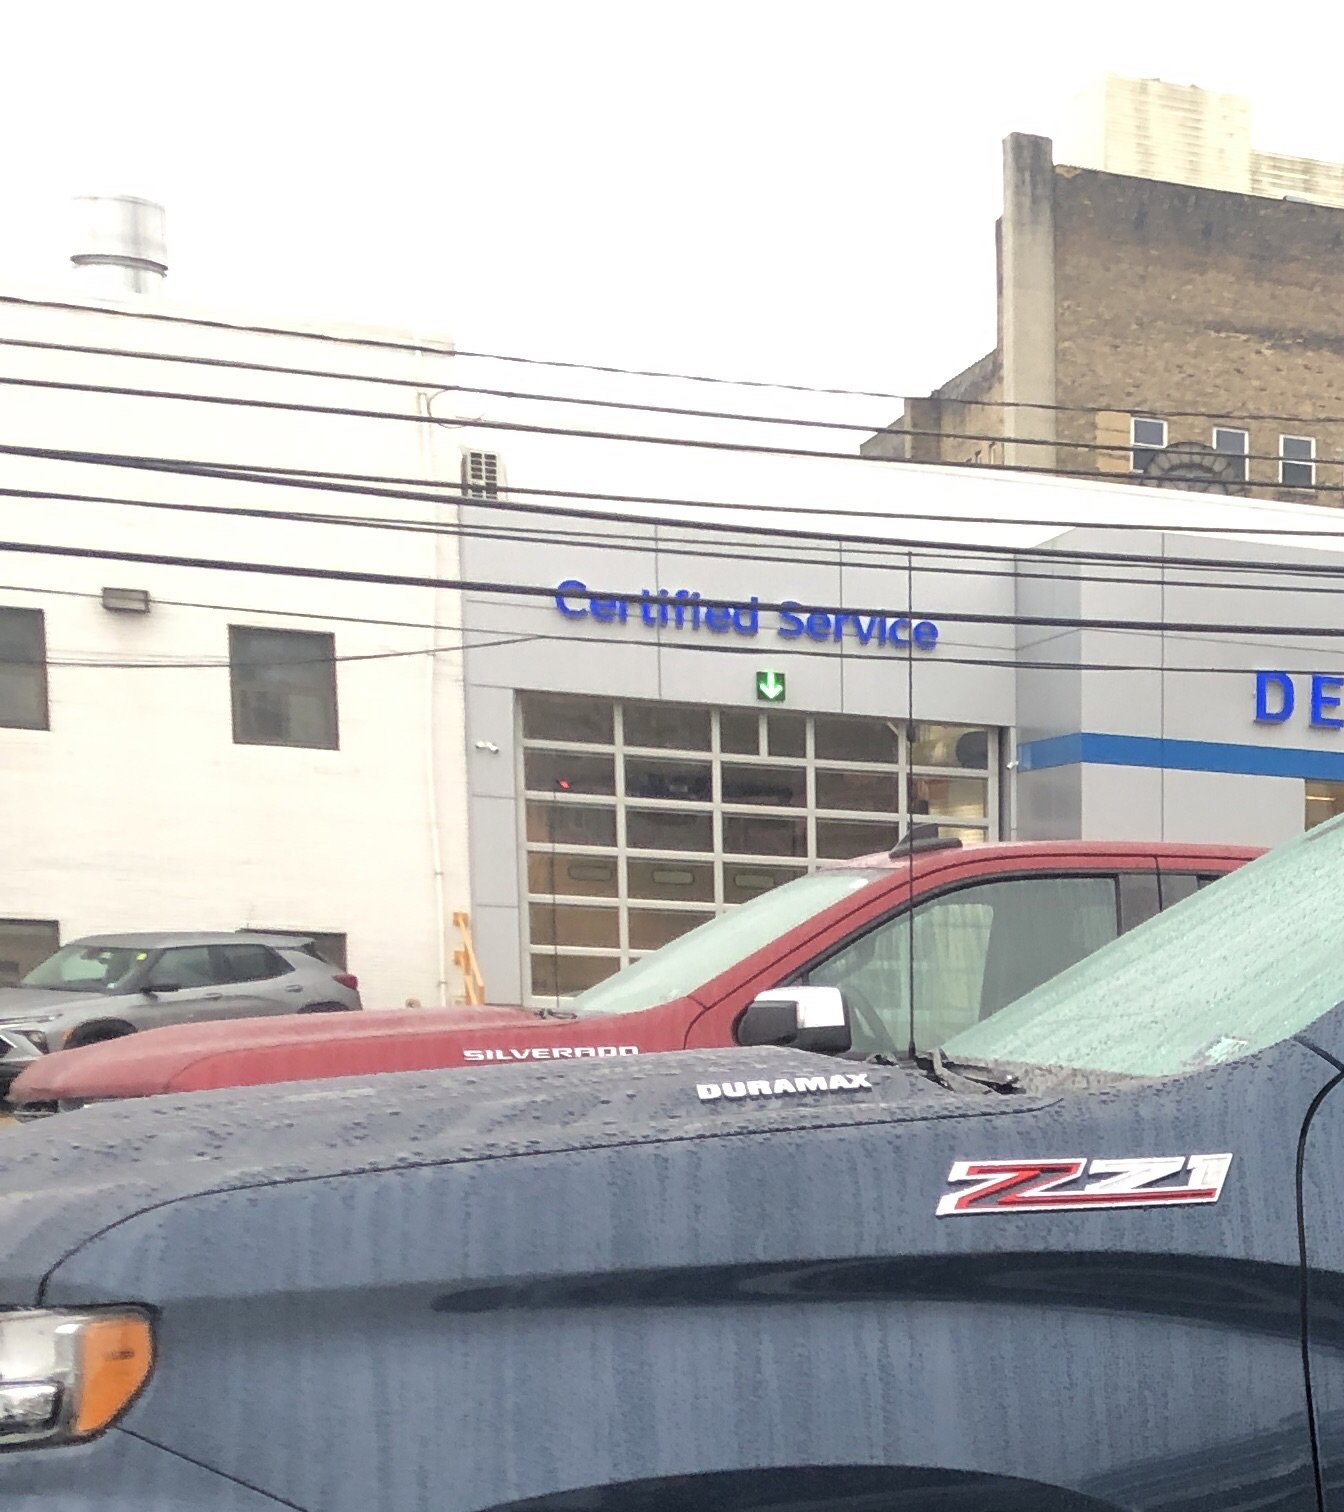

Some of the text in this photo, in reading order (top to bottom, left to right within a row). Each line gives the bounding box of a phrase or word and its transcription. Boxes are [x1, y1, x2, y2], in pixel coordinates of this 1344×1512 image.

[554, 580, 939, 651] Certified Service
[463, 1045, 640, 1061] SILVERADO
[696, 1073, 873, 1100] DURAMAX
[935, 1153, 1234, 1216] Z71
